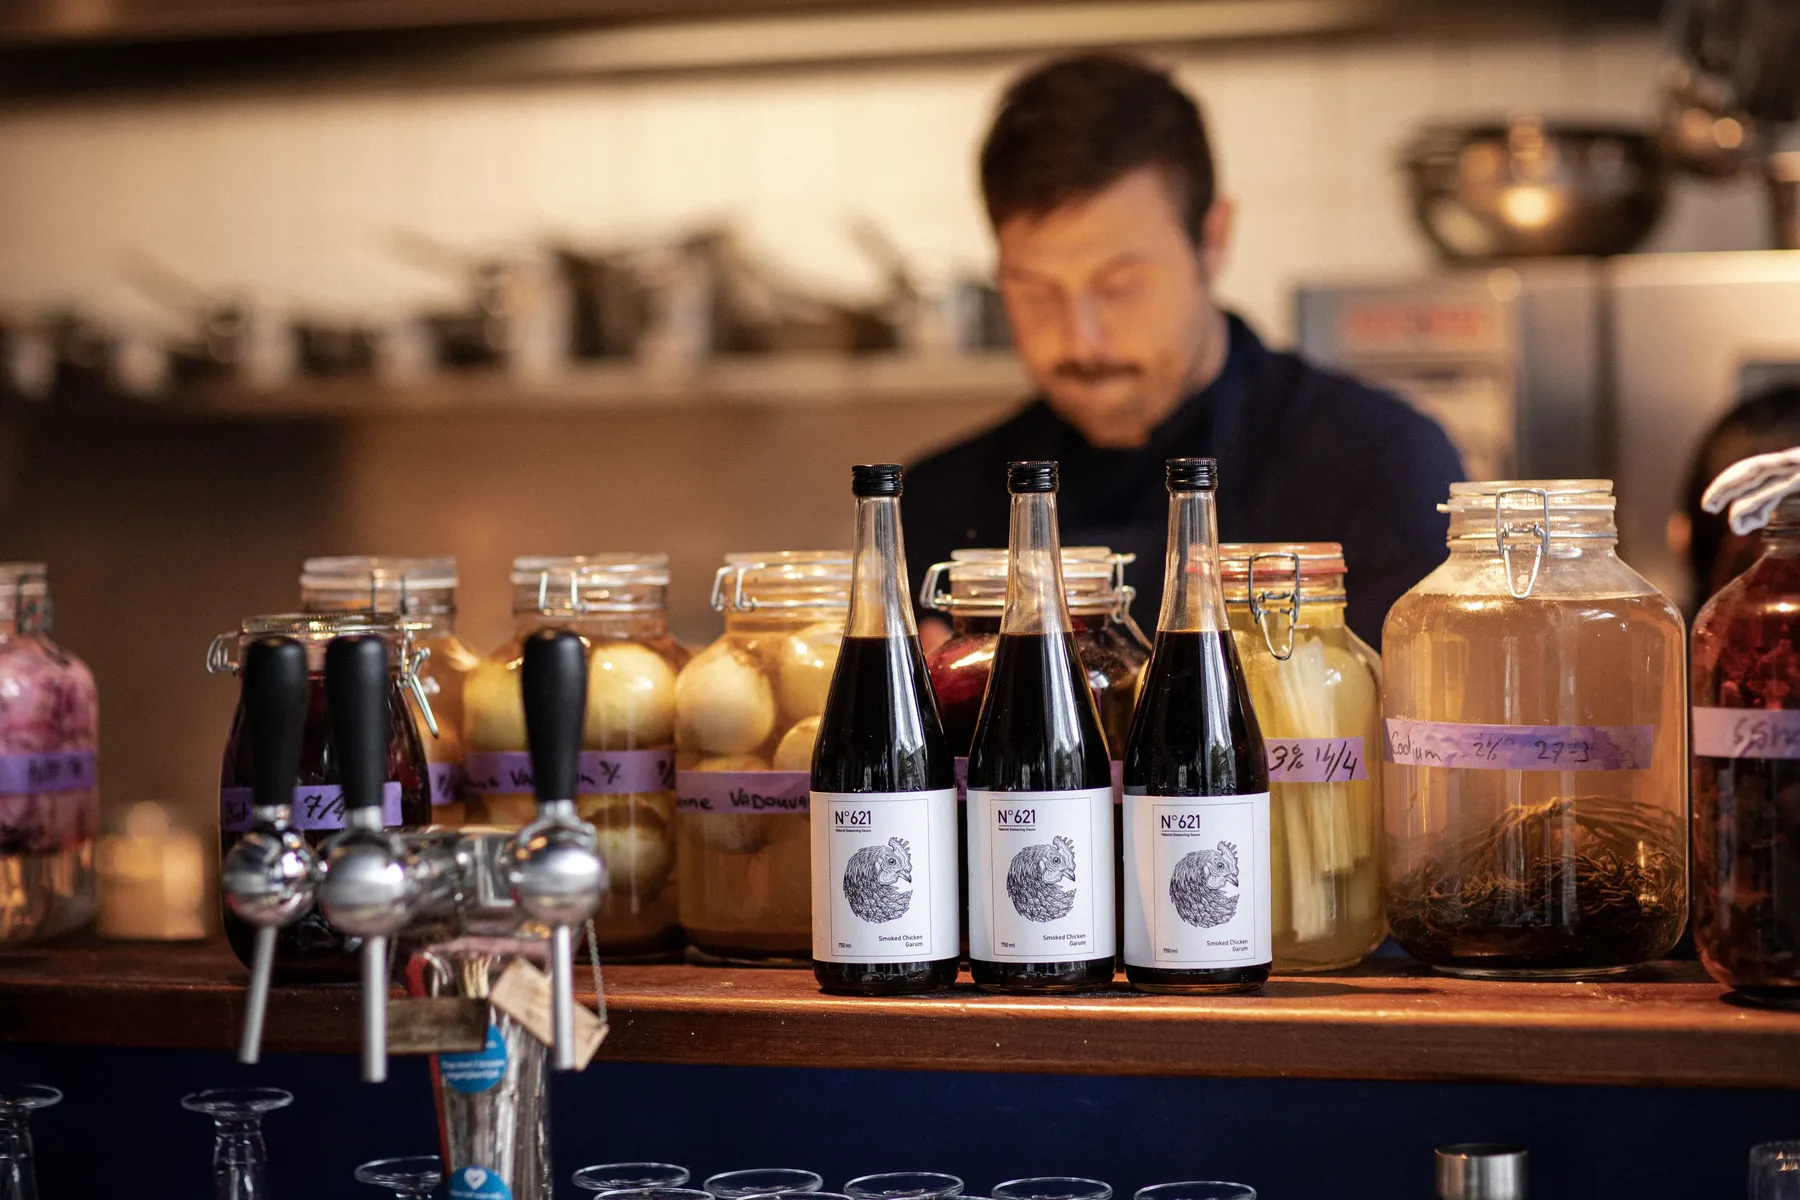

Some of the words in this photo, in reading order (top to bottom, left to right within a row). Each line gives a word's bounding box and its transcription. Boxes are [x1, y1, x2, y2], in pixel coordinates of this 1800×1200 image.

[1391, 731, 1443, 762] Codium
[1473, 737, 1503, 761] 2%
[1269, 743, 1304, 772] 3%
[835, 810, 871, 825] N°621
[998, 809, 1036, 824] N°621
[1161, 814, 1200, 829] N°621
[1229, 938, 1249, 946] Chicken
